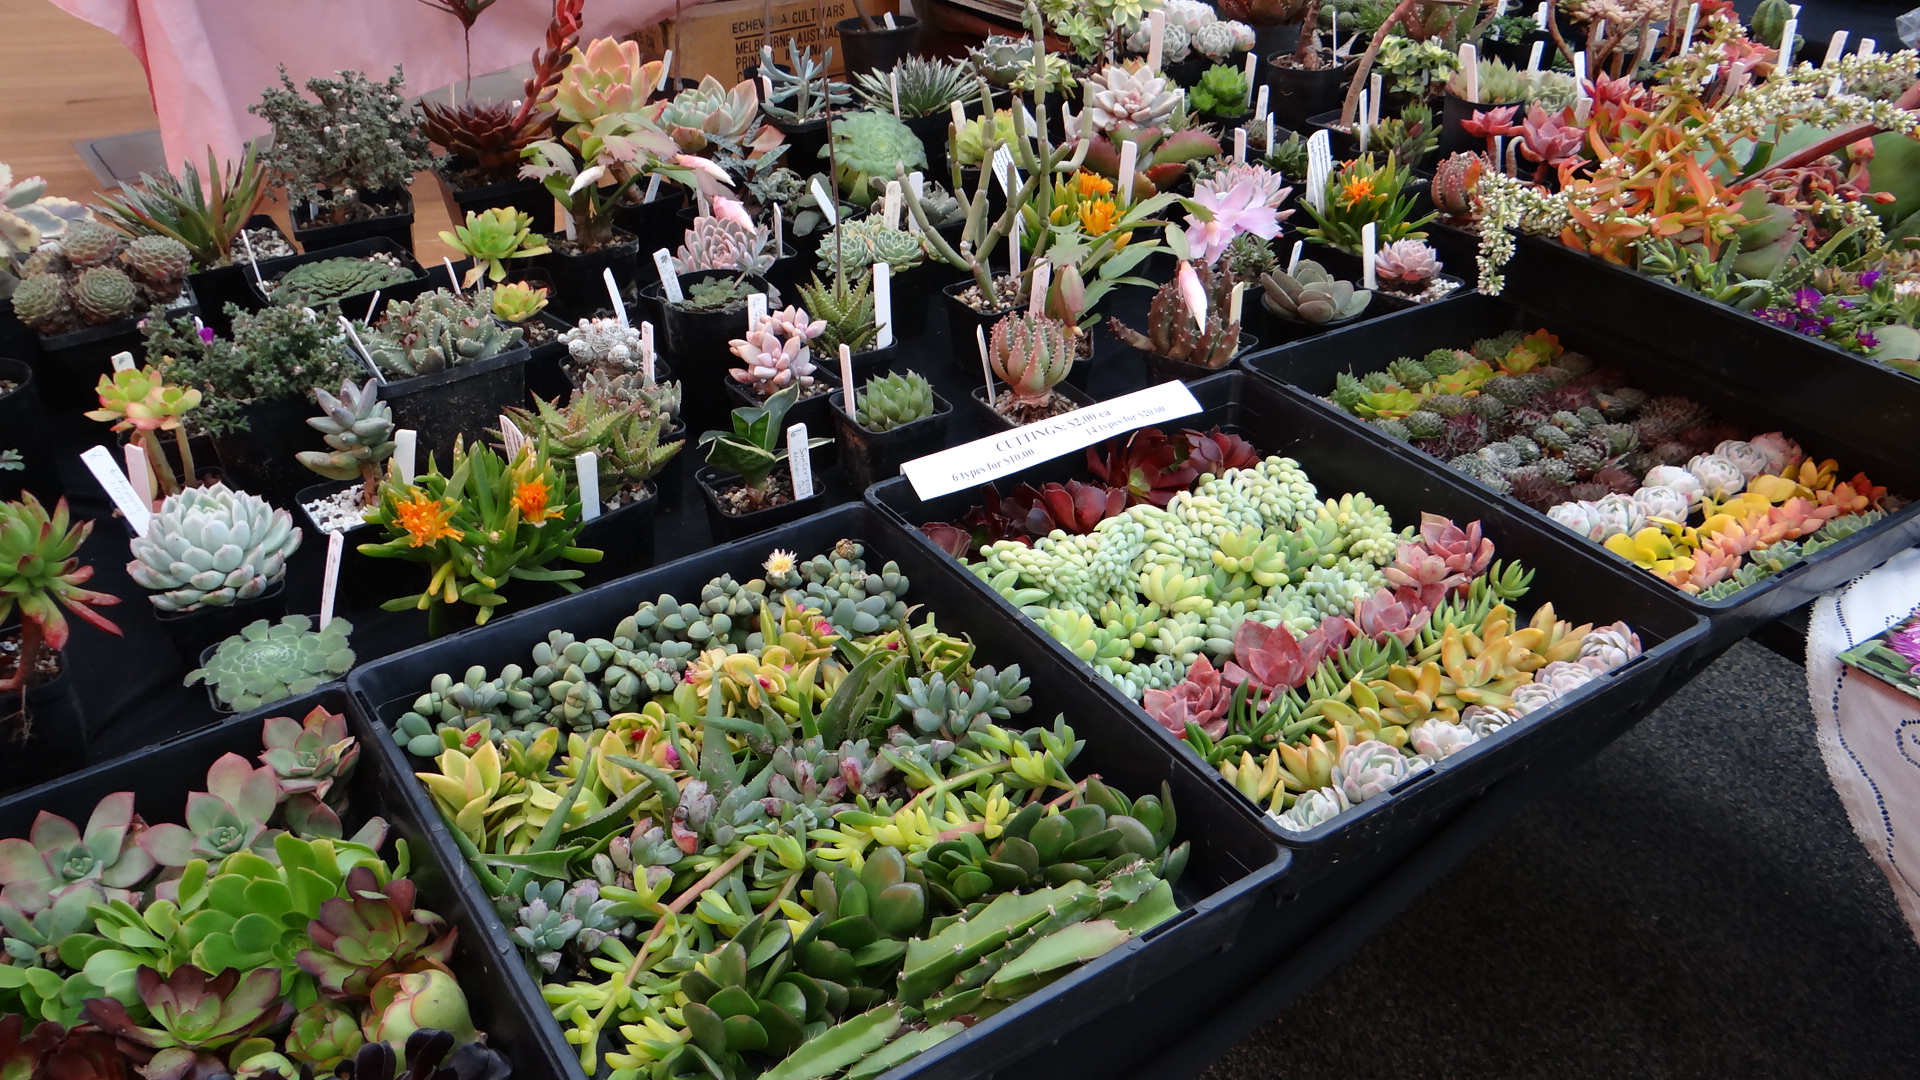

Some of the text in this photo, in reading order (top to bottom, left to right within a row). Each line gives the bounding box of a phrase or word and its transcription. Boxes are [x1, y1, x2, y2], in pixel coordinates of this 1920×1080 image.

[732, 3, 845, 34] ECHEVA CULTVARS
[735, 50, 776, 70] PRINTD
[951, 473, 959, 482] 6
[960, 467, 986, 480] types
[986, 461, 1001, 471] for
[1002, 448, 1035, 465] $10.00
[1098, 418, 1123, 432] types
[1122, 414, 1137, 423] for
[996, 409, 1112, 452] CUTTINGS: $2.00 ea
